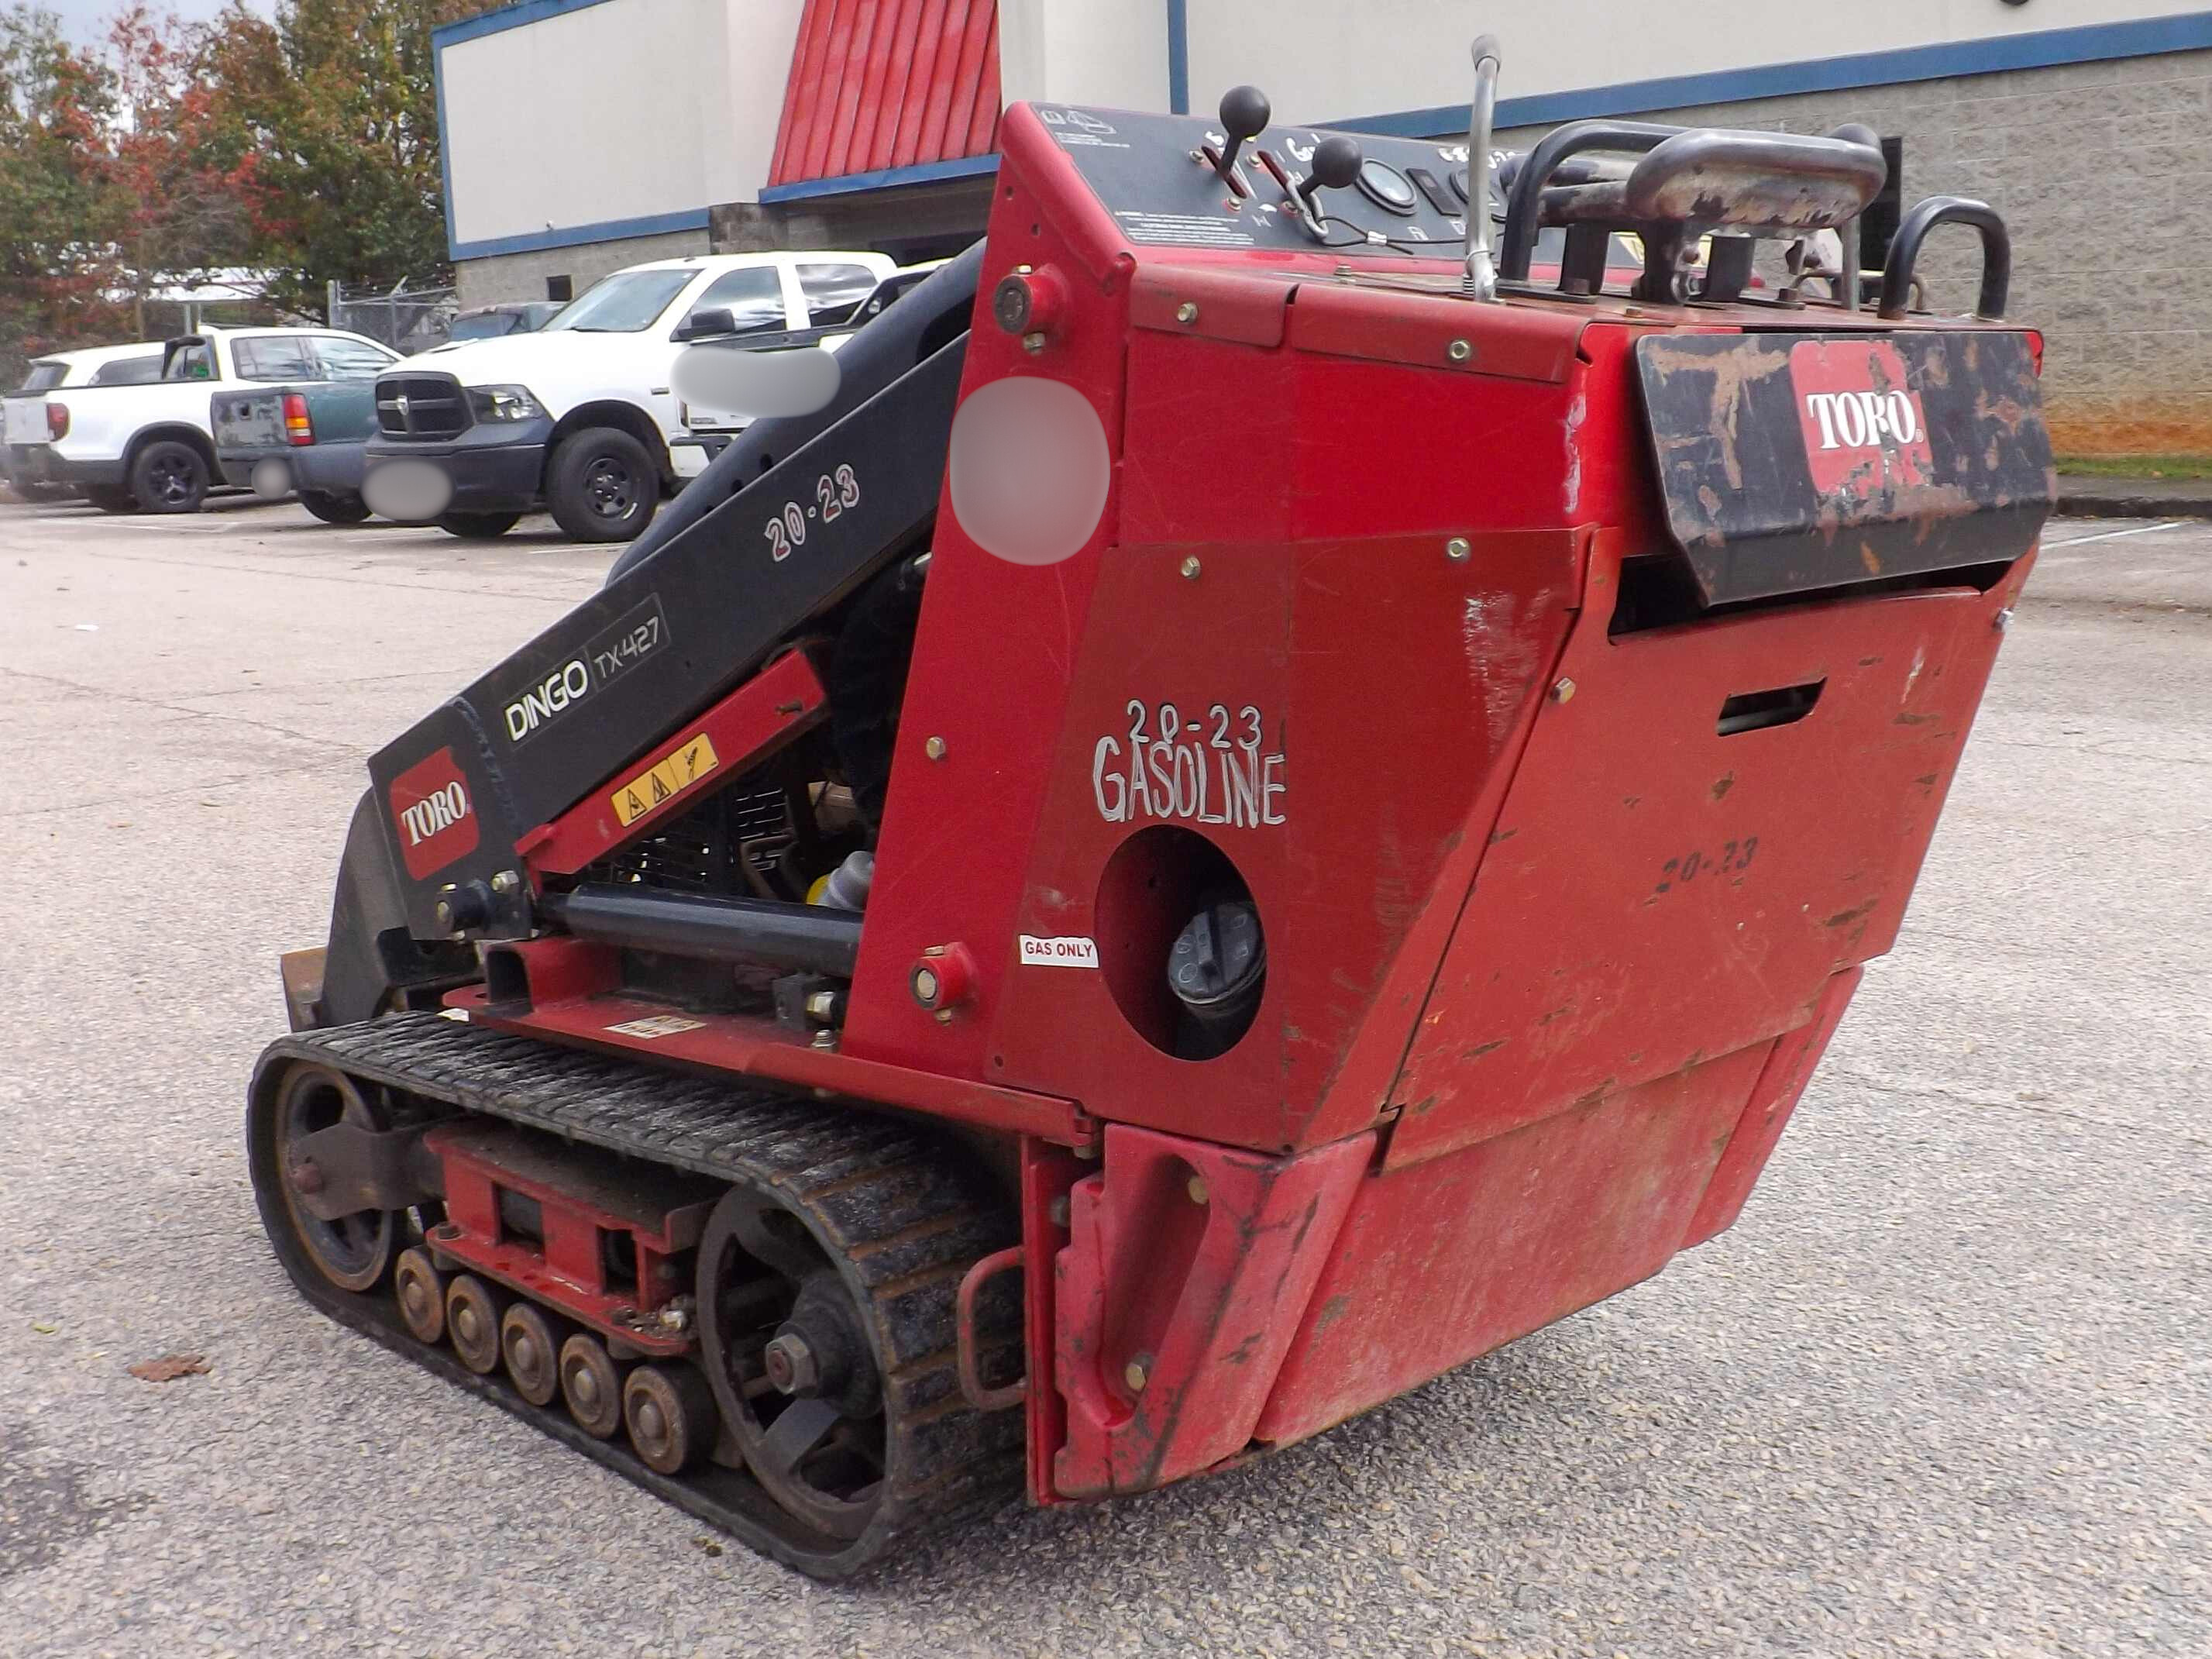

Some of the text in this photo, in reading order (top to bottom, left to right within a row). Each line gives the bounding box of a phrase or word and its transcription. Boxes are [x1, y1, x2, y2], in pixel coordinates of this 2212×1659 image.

[1806, 390, 1915, 449] TORO
[505, 660, 589, 742] DINGO
[1127, 700, 1262, 750] 20-23
[1093, 736, 1286, 828] GASOLINE
[401, 781, 466, 846] TORO
[1025, 941, 1092, 957] GAS ONLY
